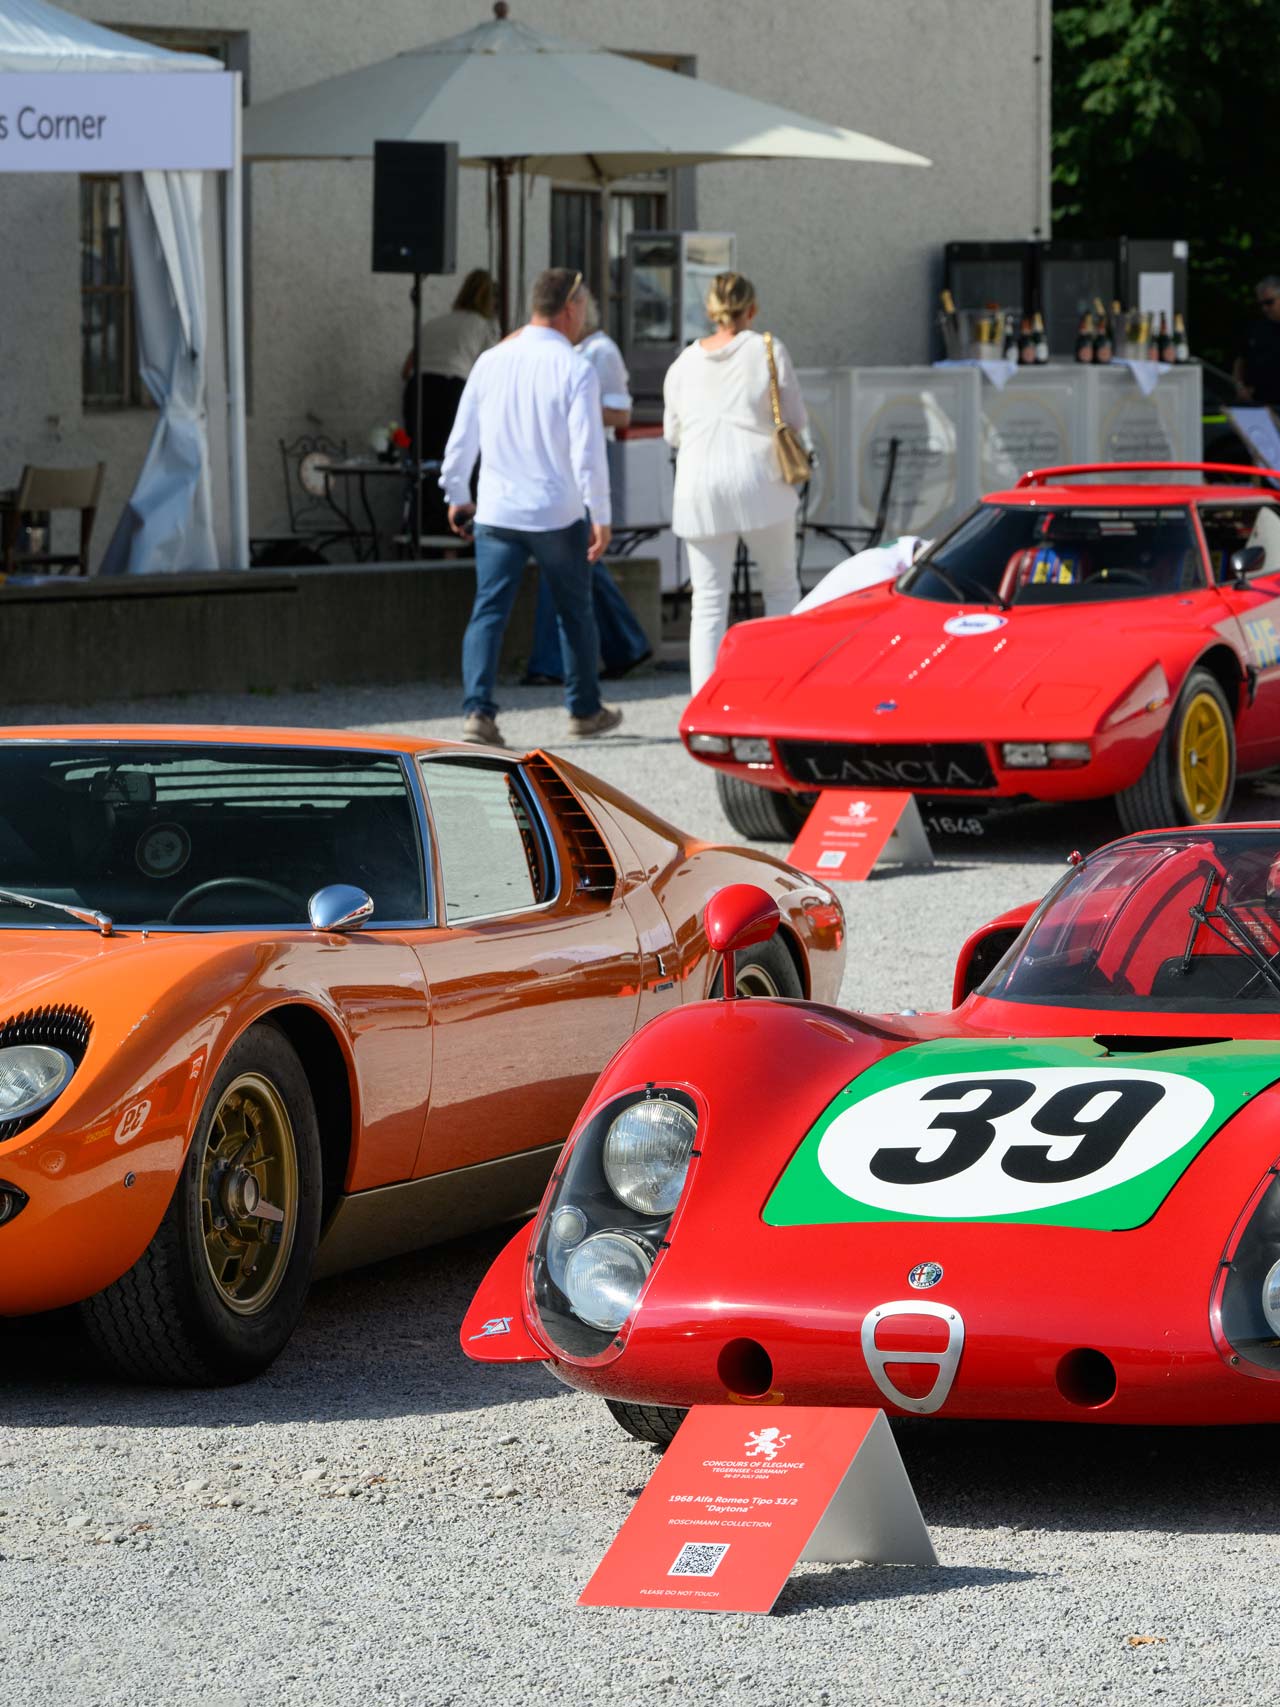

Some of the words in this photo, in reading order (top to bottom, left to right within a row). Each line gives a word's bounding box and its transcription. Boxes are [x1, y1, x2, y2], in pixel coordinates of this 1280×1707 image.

[17, 105, 107, 140] Corner
[805, 757, 976, 785] LANCIA
[869, 1078, 1166, 1185] 39
[702, 1460, 749, 1468] CONCOURS
[668, 1495, 694, 1503] 1968
[694, 1495, 713, 1503] Alfa
[715, 1496, 750, 1504] Romeo
[752, 1497, 773, 1506] Tipo
[774, 1498, 799, 1506] 33/2
[668, 1519, 720, 1527] ROSCHMANN
[721, 1520, 772, 1528] COLLECTION
